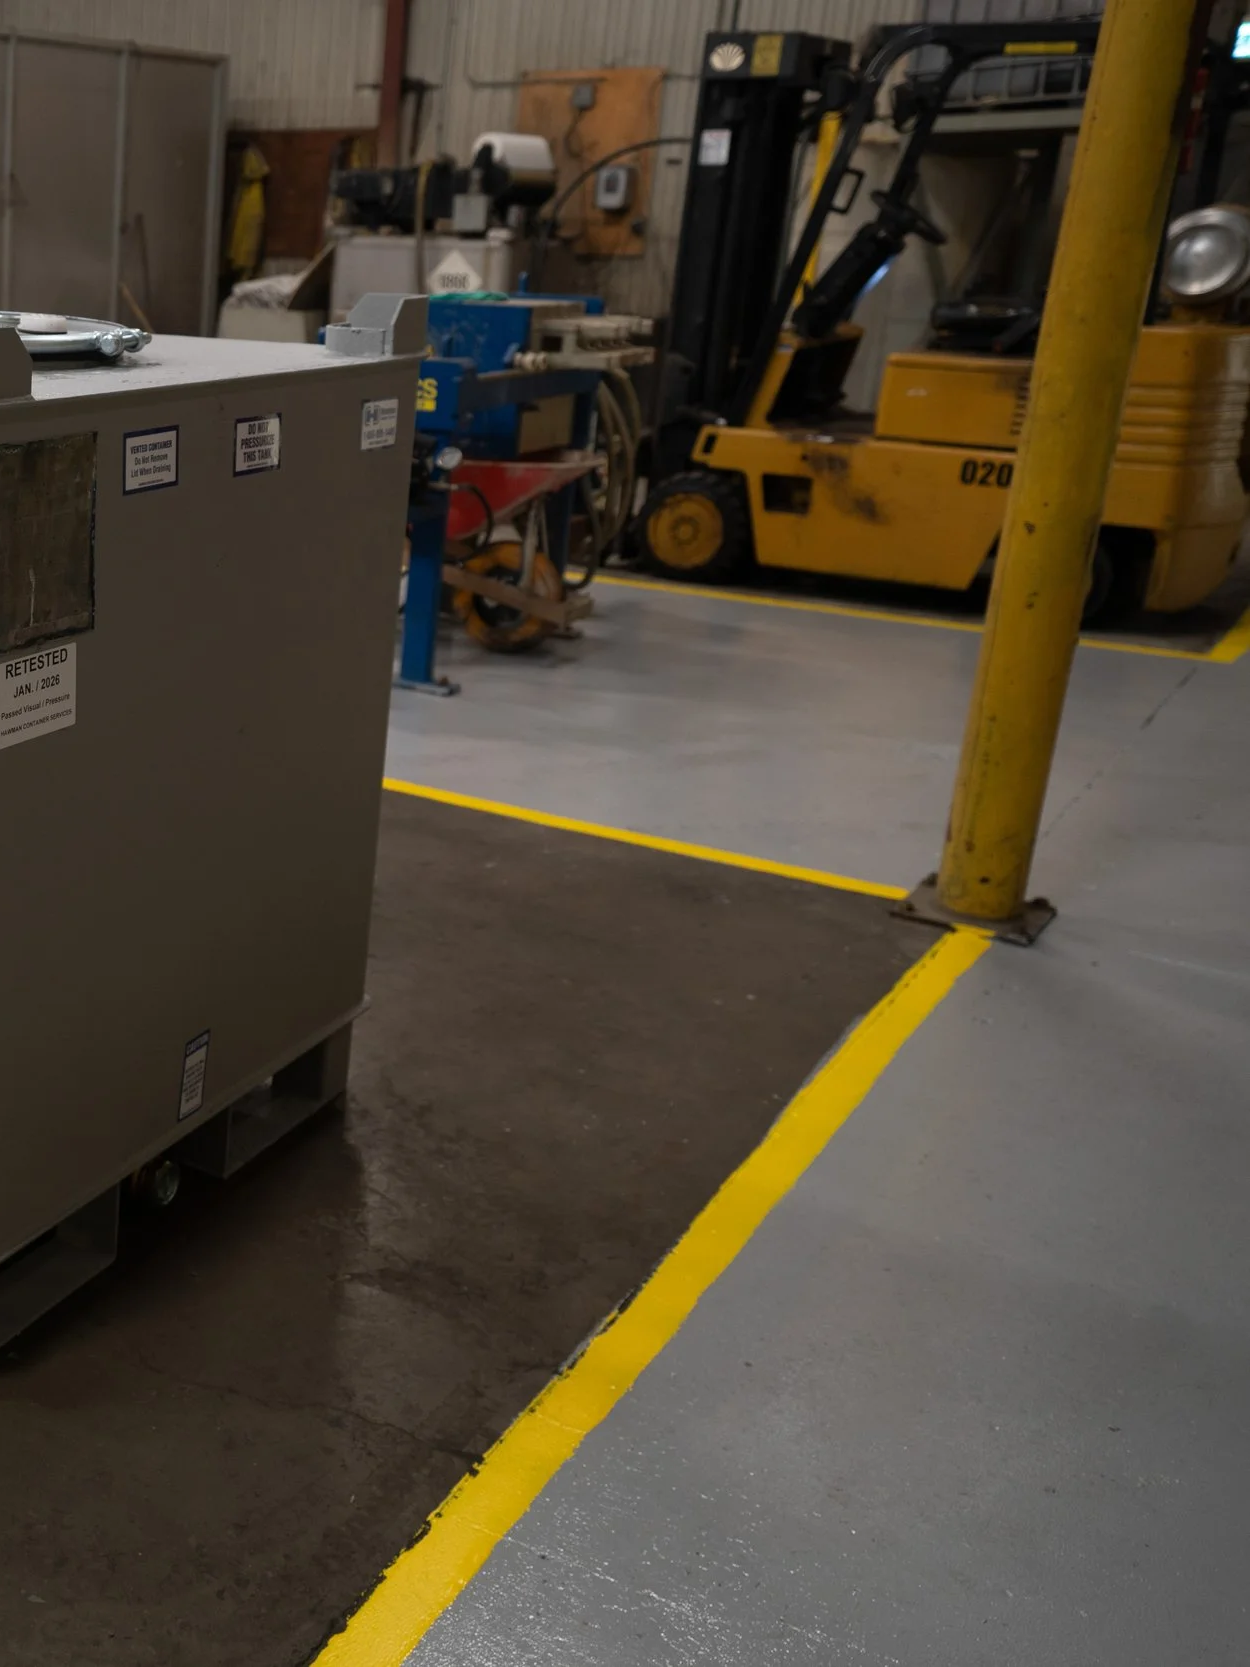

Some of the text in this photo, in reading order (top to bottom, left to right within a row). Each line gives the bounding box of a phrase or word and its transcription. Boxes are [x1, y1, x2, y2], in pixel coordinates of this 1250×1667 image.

[248, 423, 257, 435] DO
[130, 440, 173, 455] VENTED CONTAINER
[243, 450, 257, 464] THIS
[5, 647, 69, 680] RETESTED
[13, 682, 35, 698] JAN.
[40, 674, 60, 690] 2026
[0, 706, 23, 720] Passed
[23, 700, 41, 714] Visual
[45, 693, 71, 707] Pressure
[23, 715, 50, 730] CONTAINER
[50, 708, 73, 721] SERVICES
